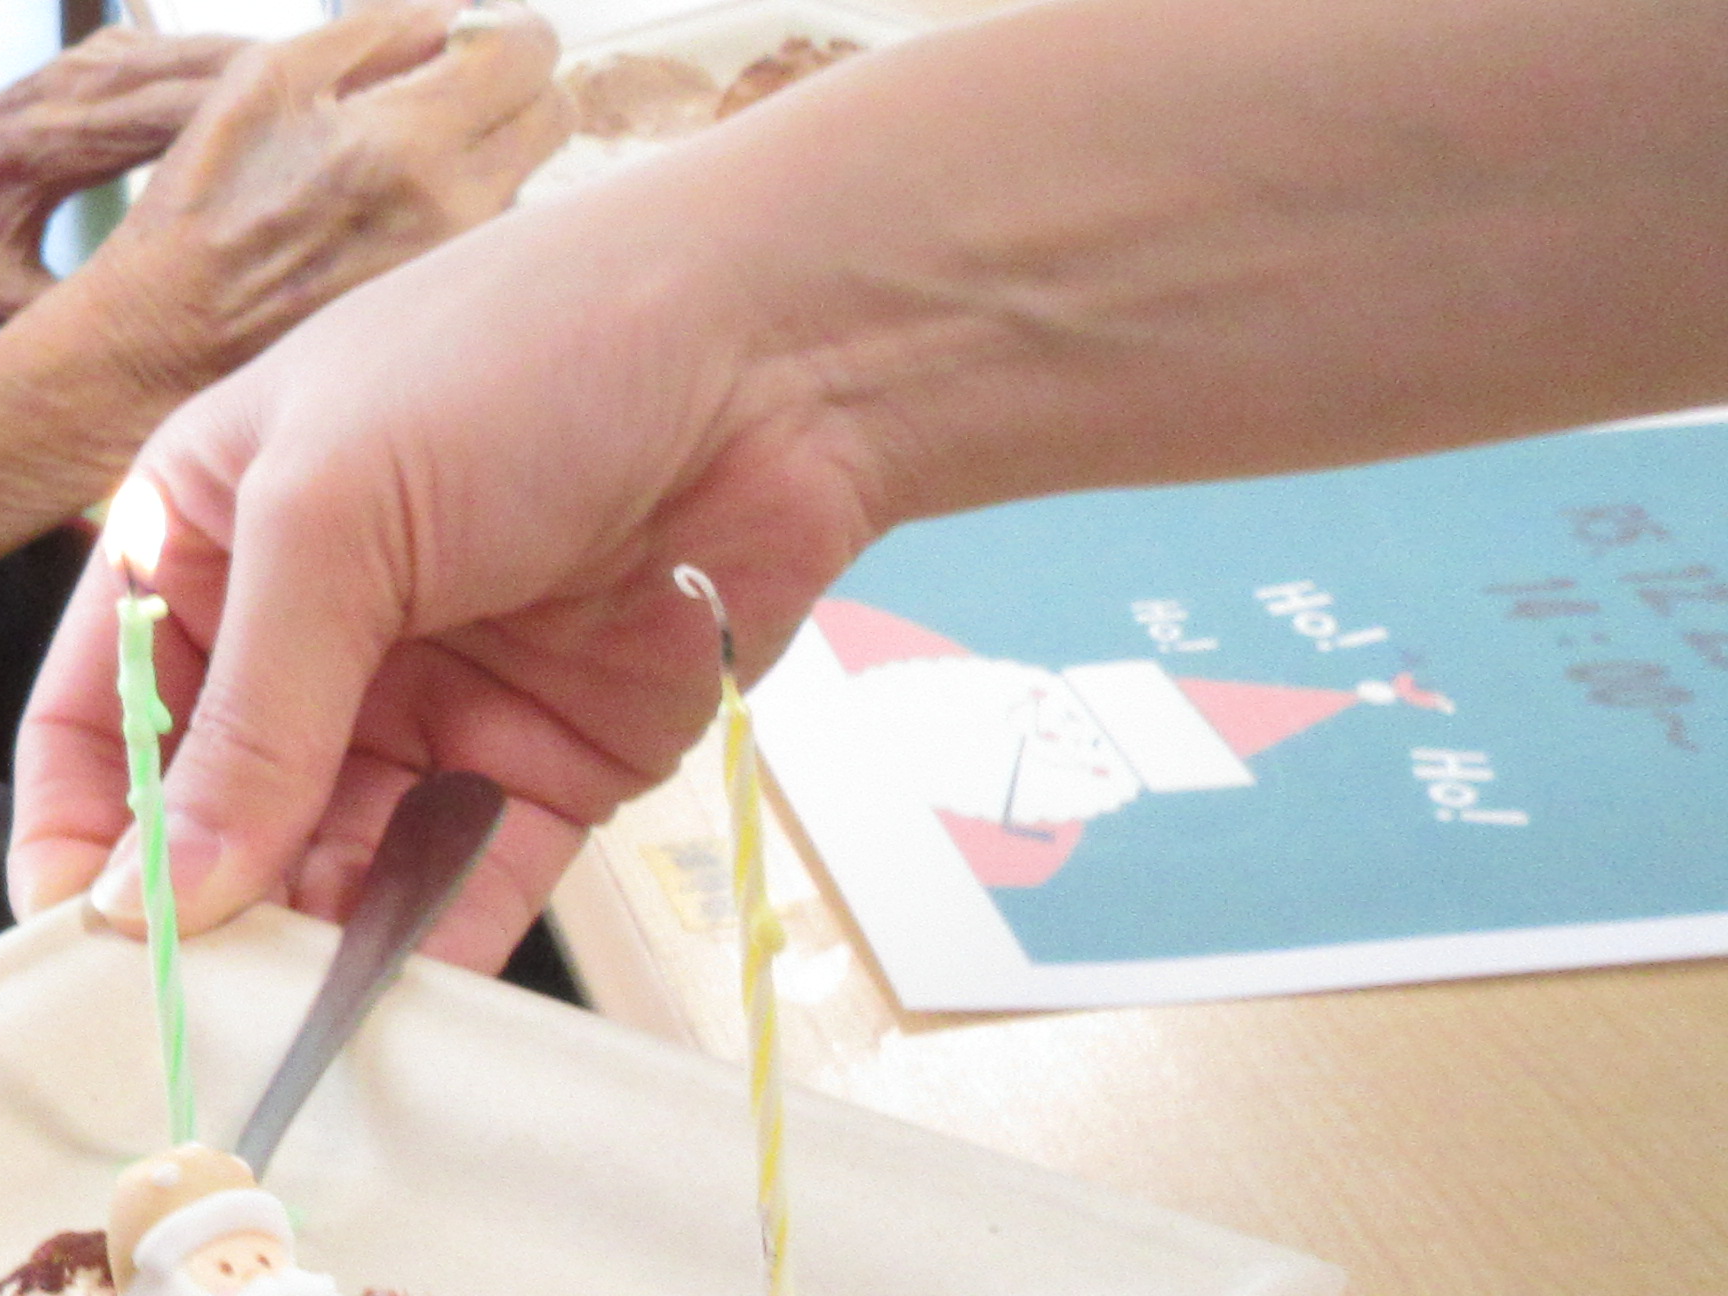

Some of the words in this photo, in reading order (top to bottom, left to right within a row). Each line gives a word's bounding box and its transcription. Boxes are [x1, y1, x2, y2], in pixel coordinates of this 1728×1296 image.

[1131, 600, 1219, 654] Ho!
[1254, 580, 1389, 652] Ho!
[1410, 748, 1530, 826] Ho!
